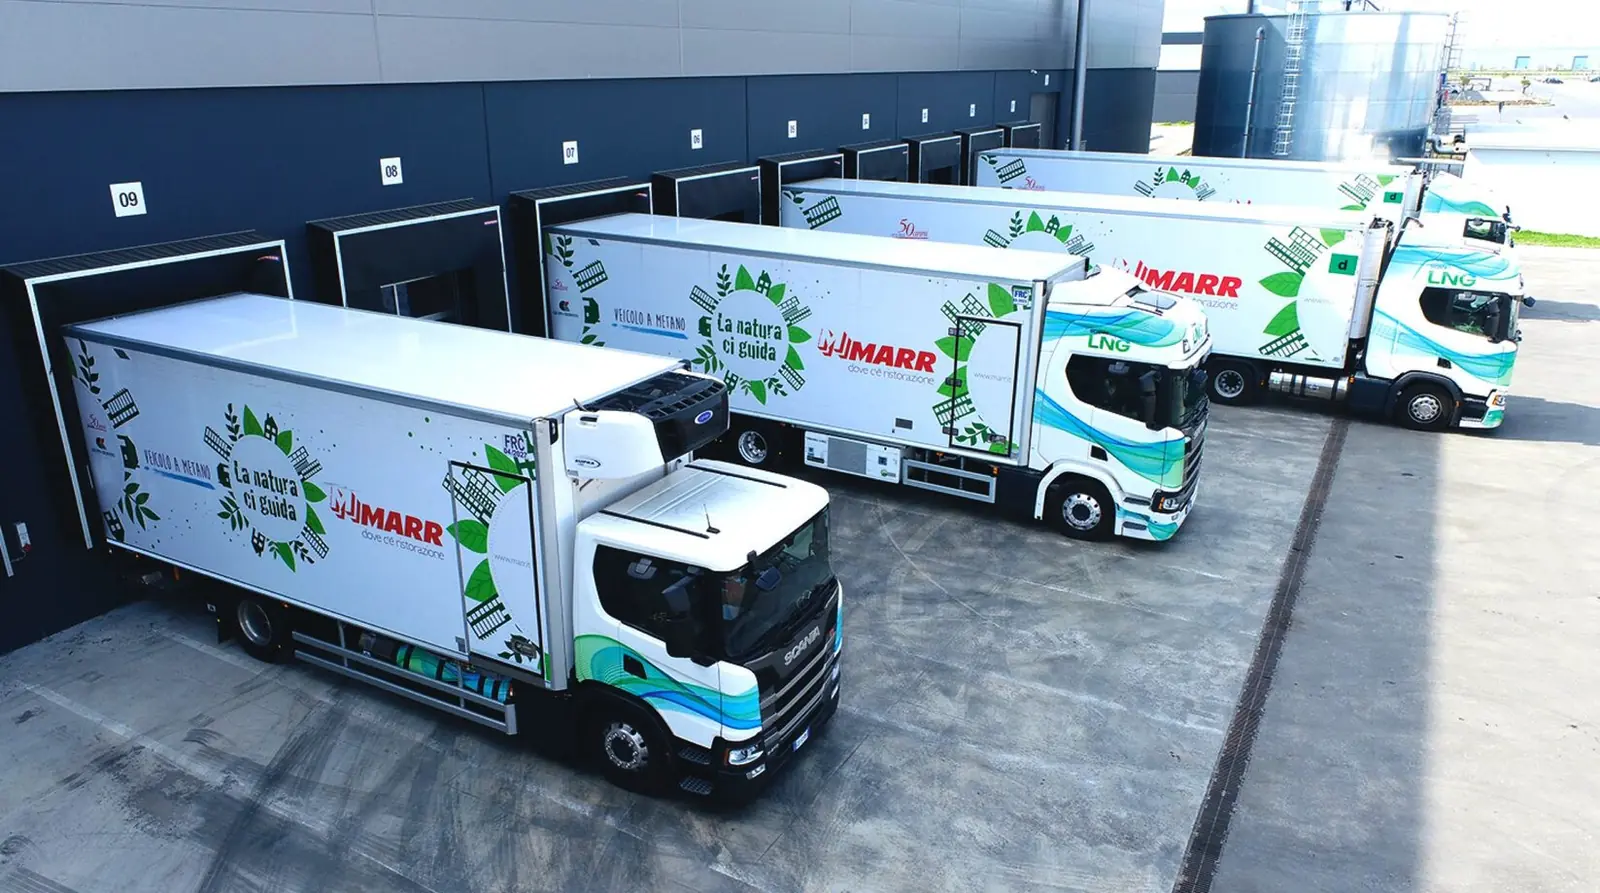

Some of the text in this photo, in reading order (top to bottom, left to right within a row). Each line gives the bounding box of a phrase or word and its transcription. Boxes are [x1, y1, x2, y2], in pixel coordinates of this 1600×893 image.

[693, 134, 701, 145] 06
[566, 147, 575, 158] 07
[385, 164, 398, 179] 08
[118, 191, 139, 208] 09
[899, 218, 915, 237] 50
[1337, 259, 1349, 273] d
[1145, 268, 1243, 298] MARR
[1428, 270, 1477, 287] LNG
[1014, 290, 1028, 299] FRC
[614, 308, 686, 331] VEICOLO A METANO
[717, 313, 782, 341] La natura
[722, 336, 777, 362] ci guida
[1088, 334, 1131, 353] LNG
[848, 340, 937, 374] MARR
[847, 364, 869, 376] dove
[883, 367, 935, 386] ristorazione
[504, 434, 525, 451] FRC
[143, 449, 212, 481] VEICOLO A METANO
[233, 459, 299, 498] La natura
[243, 489, 298, 522] ci guida
[360, 502, 444, 547] MARR
[361, 529, 382, 543] dove
[396, 536, 446, 562] ristorazione
[784, 626, 820, 665] SCANIA
